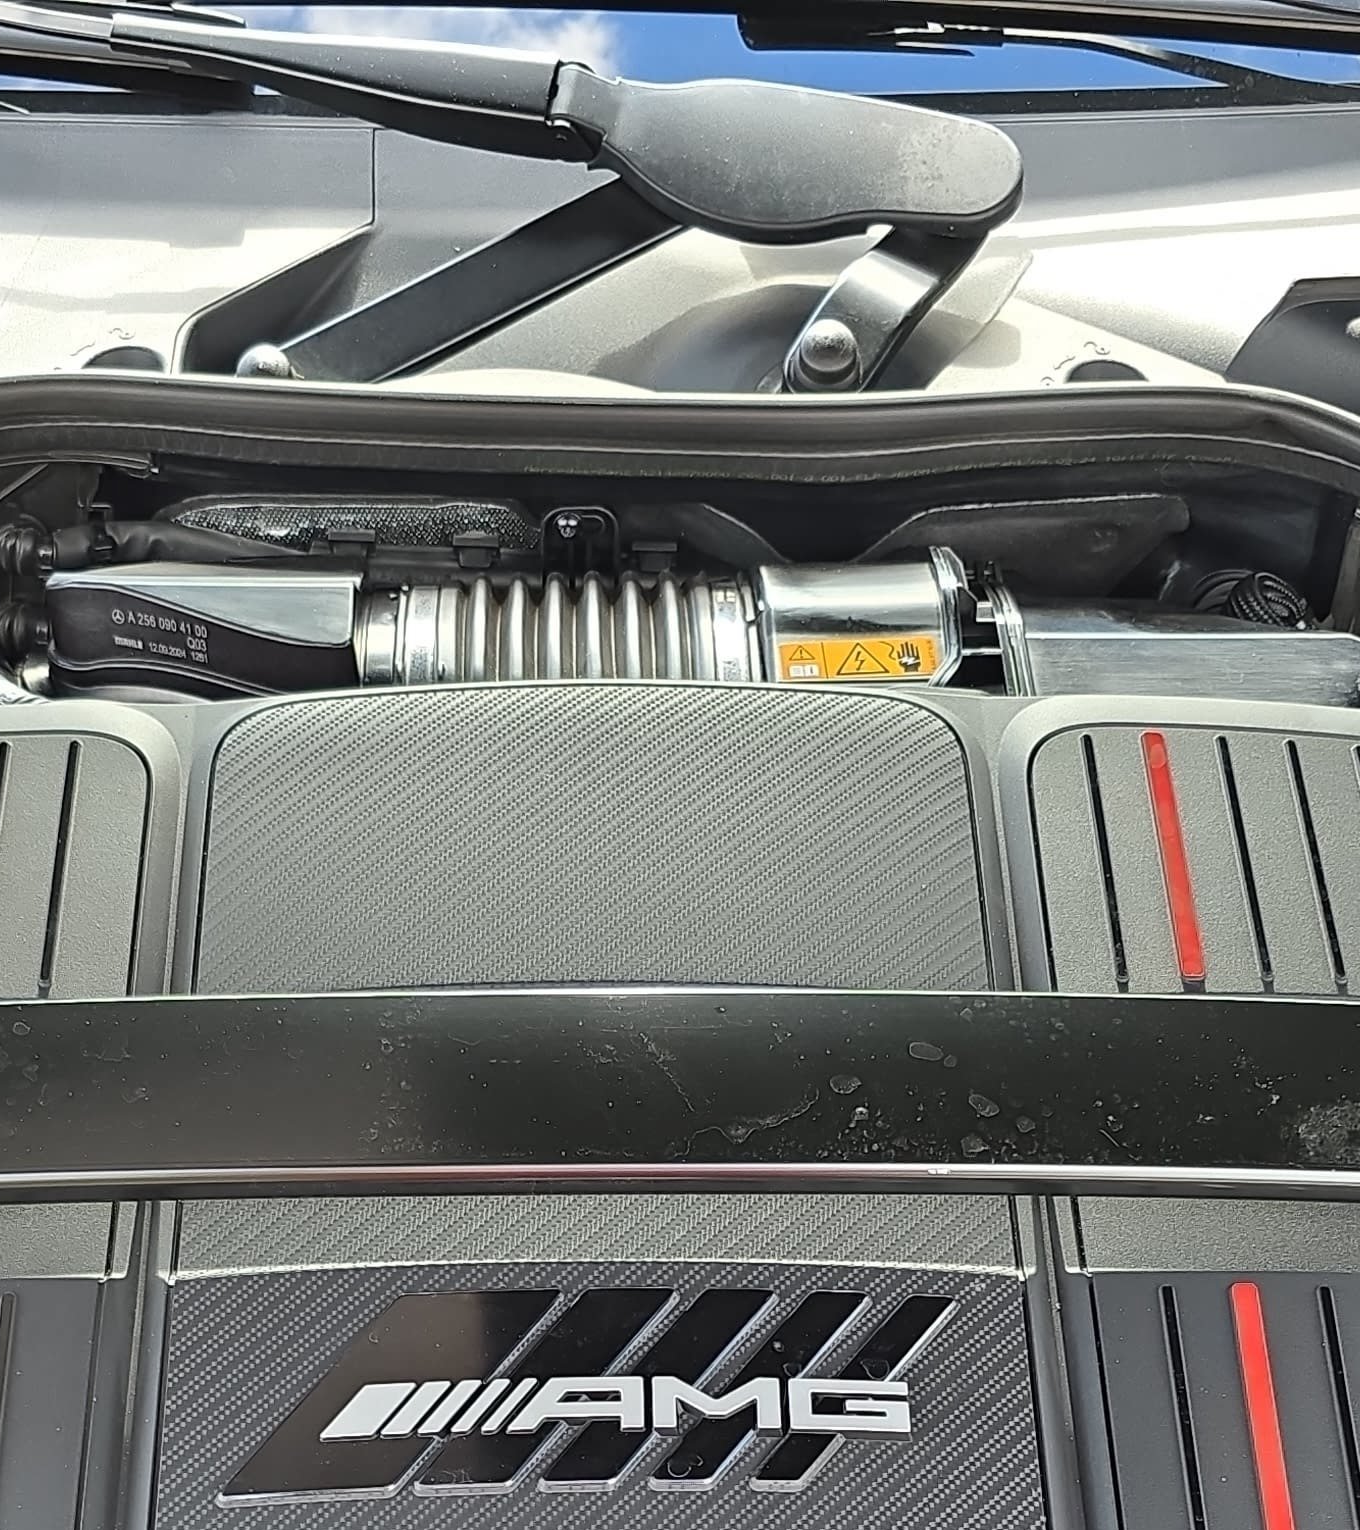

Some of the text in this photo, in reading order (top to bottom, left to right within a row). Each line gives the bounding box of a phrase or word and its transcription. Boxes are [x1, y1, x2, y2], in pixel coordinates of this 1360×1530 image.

[127, 611, 208, 638] A 256 090 41 00
[506, 1375, 913, 1437] AMG
